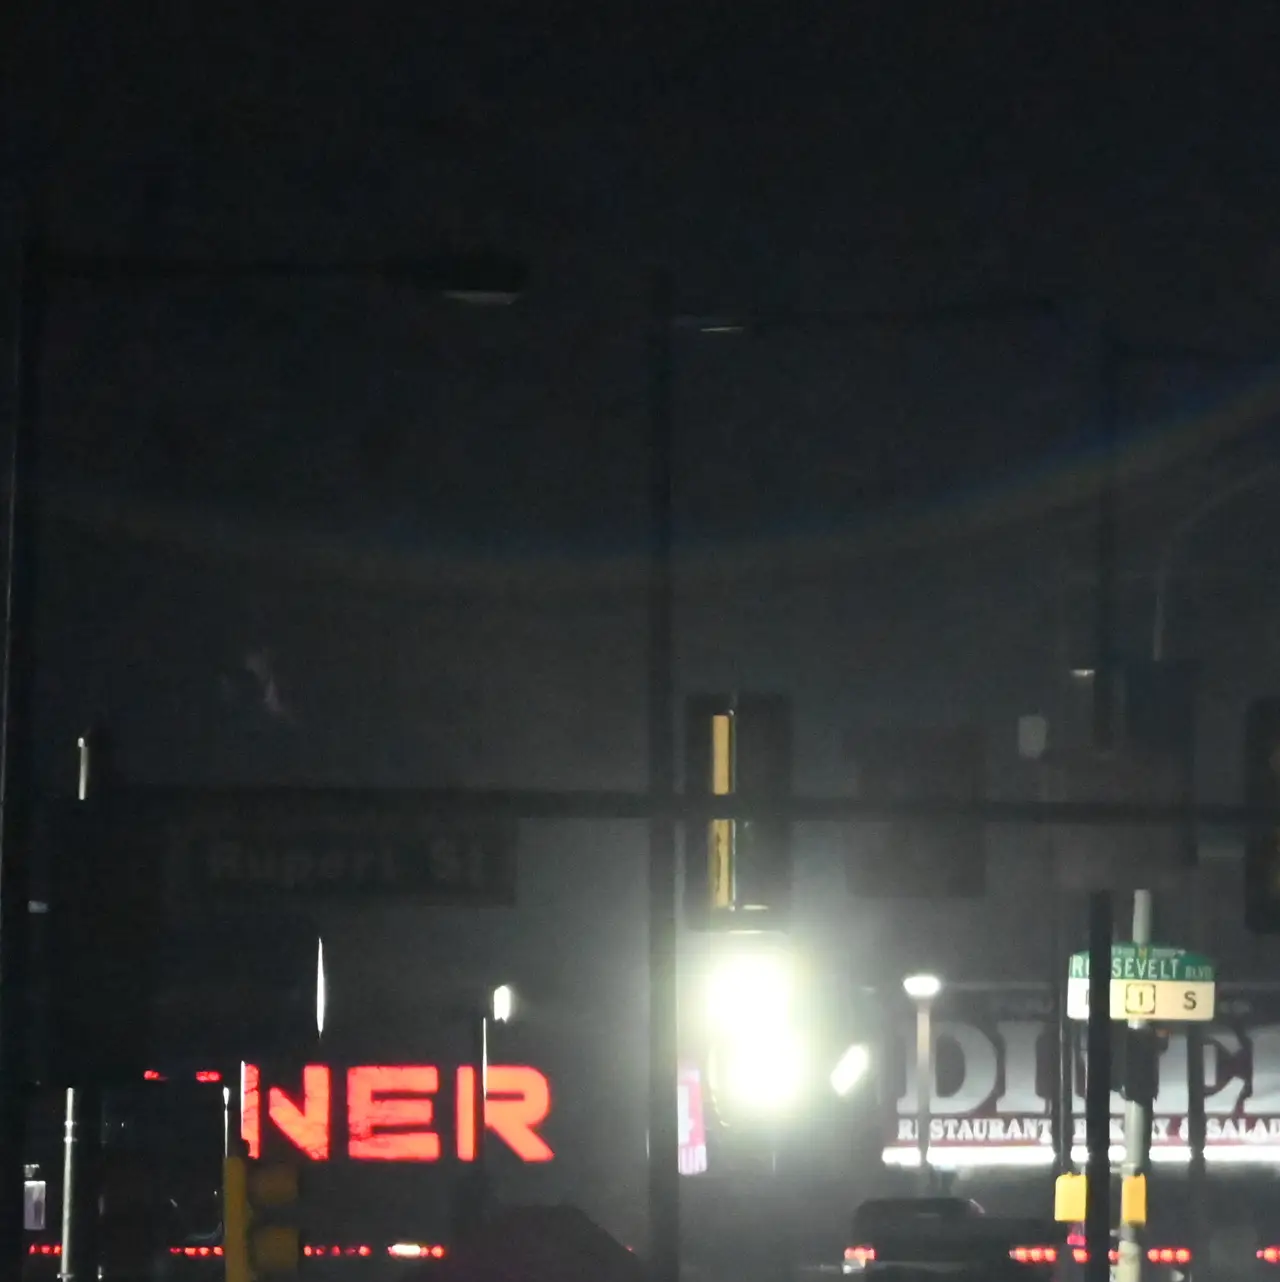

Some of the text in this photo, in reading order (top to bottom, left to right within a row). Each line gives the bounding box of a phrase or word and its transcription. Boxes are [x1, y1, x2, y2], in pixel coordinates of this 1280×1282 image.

[1069, 953, 1180, 979] RSEVELT
[1183, 990, 1198, 1010] S
[241, 1063, 557, 1162] NER
[898, 1117, 1052, 1142] RSTAURANT
